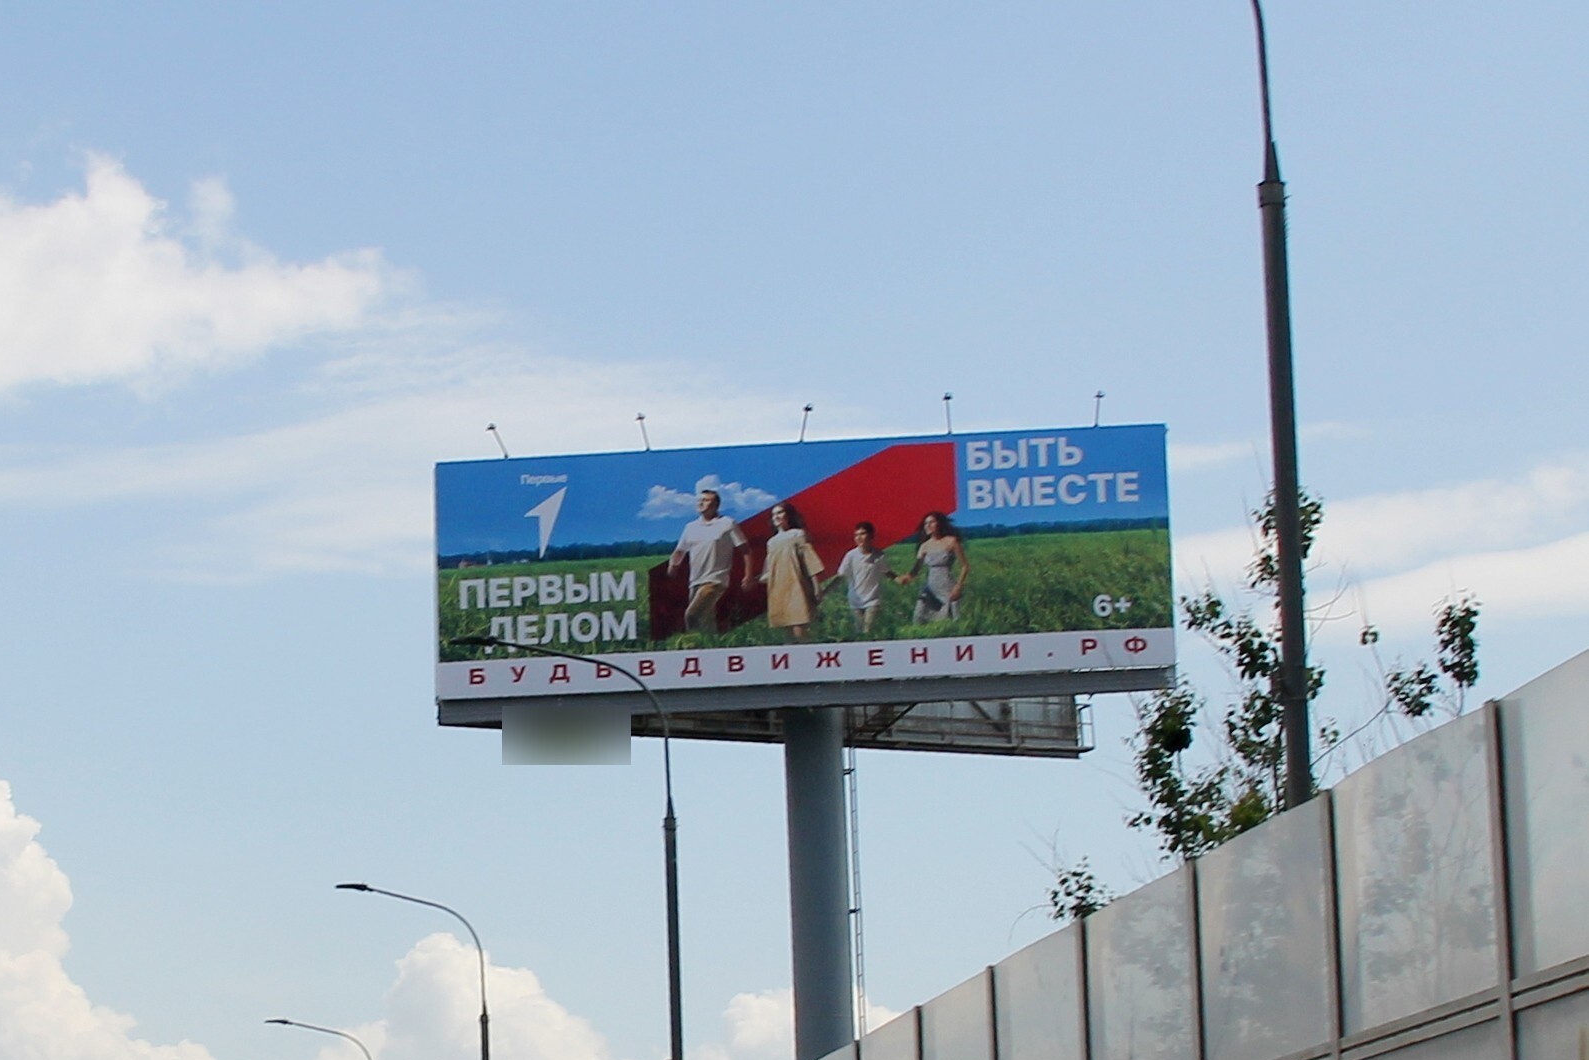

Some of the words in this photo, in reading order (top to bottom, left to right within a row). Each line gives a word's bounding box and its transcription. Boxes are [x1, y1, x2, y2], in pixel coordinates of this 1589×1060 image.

[965, 436, 1083, 472] БЫТЬ
[521, 473, 568, 487] Первые
[967, 471, 1141, 510] ВМЕСТЕ
[458, 570, 637, 610] ПЕРВЫМ
[1092, 594, 1132, 617] 6+
[485, 609, 638, 655] ДЕЛОМ
